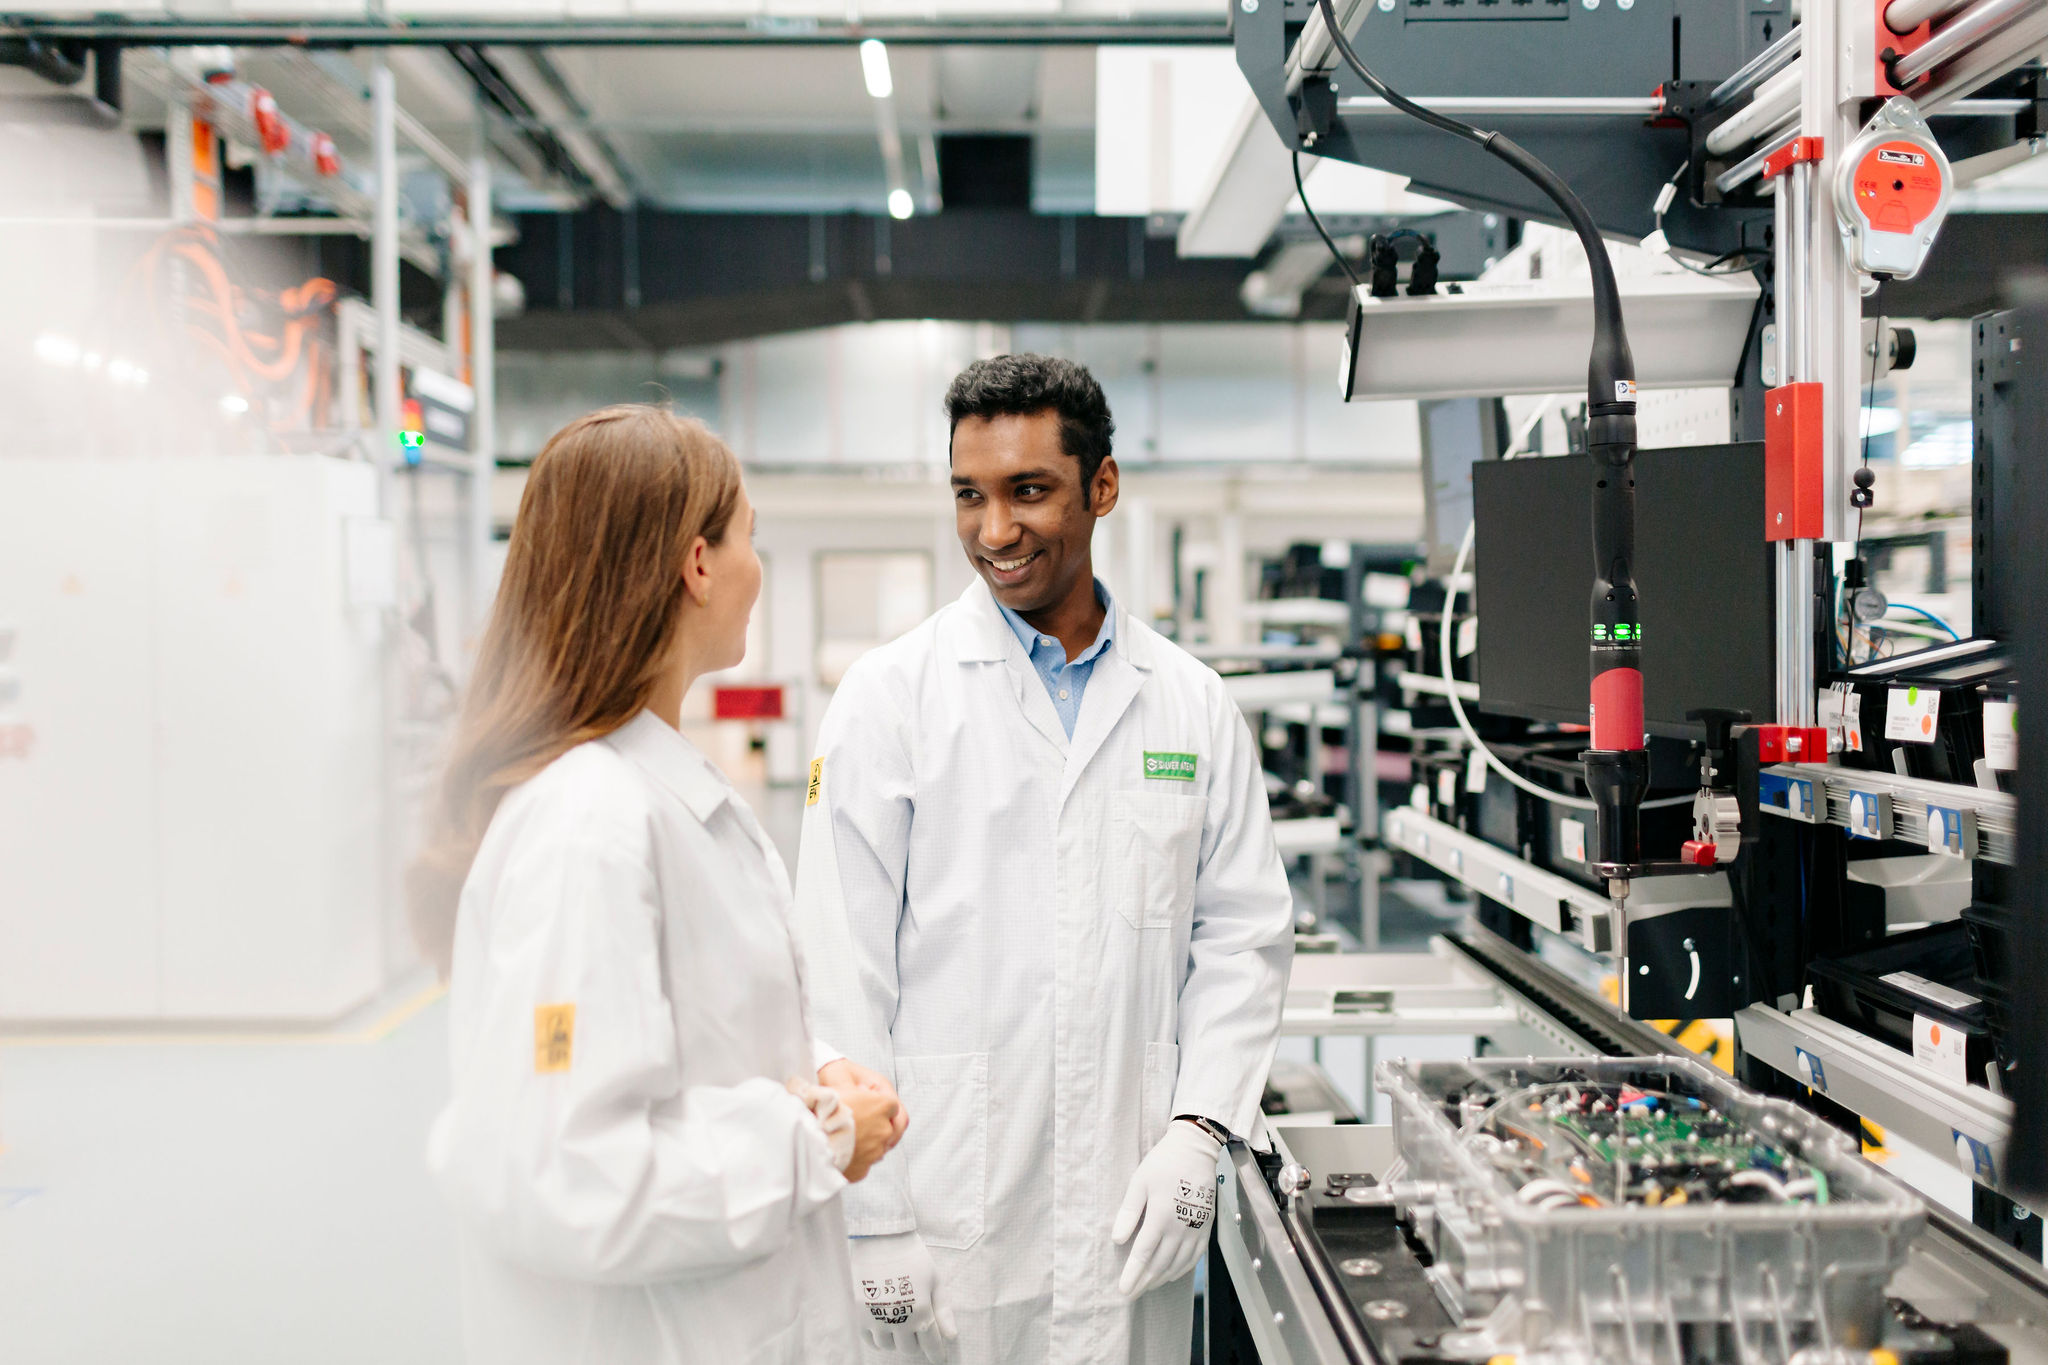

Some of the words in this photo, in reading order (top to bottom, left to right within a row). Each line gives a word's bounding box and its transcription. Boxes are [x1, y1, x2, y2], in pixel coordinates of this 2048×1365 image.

[1176, 1205, 1193, 1217] 105
[1197, 1210, 1210, 1221] LEO
[870, 1308, 887, 1316] 105
[892, 1305, 913, 1316] LEO
